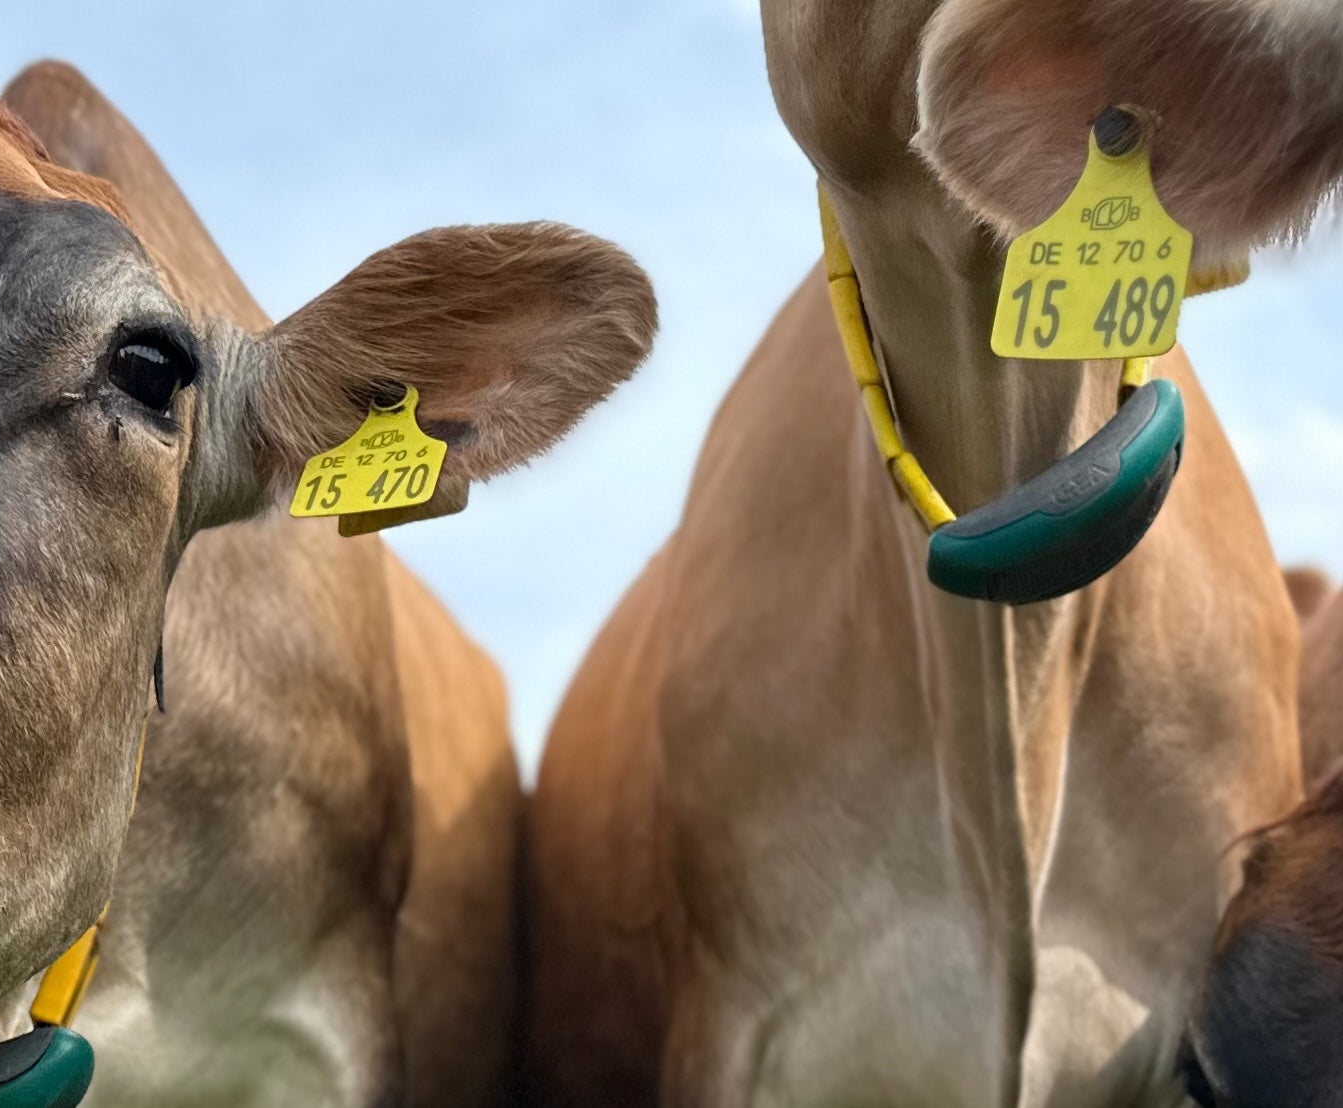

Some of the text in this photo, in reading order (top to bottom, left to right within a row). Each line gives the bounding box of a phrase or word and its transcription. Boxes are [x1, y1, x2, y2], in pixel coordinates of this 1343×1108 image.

[1029, 237, 1172, 265] DE 12 70 6
[1012, 274, 1175, 348] 15 489
[320, 446, 428, 469] DE 12 70 6
[306, 463, 429, 510] 15 470
